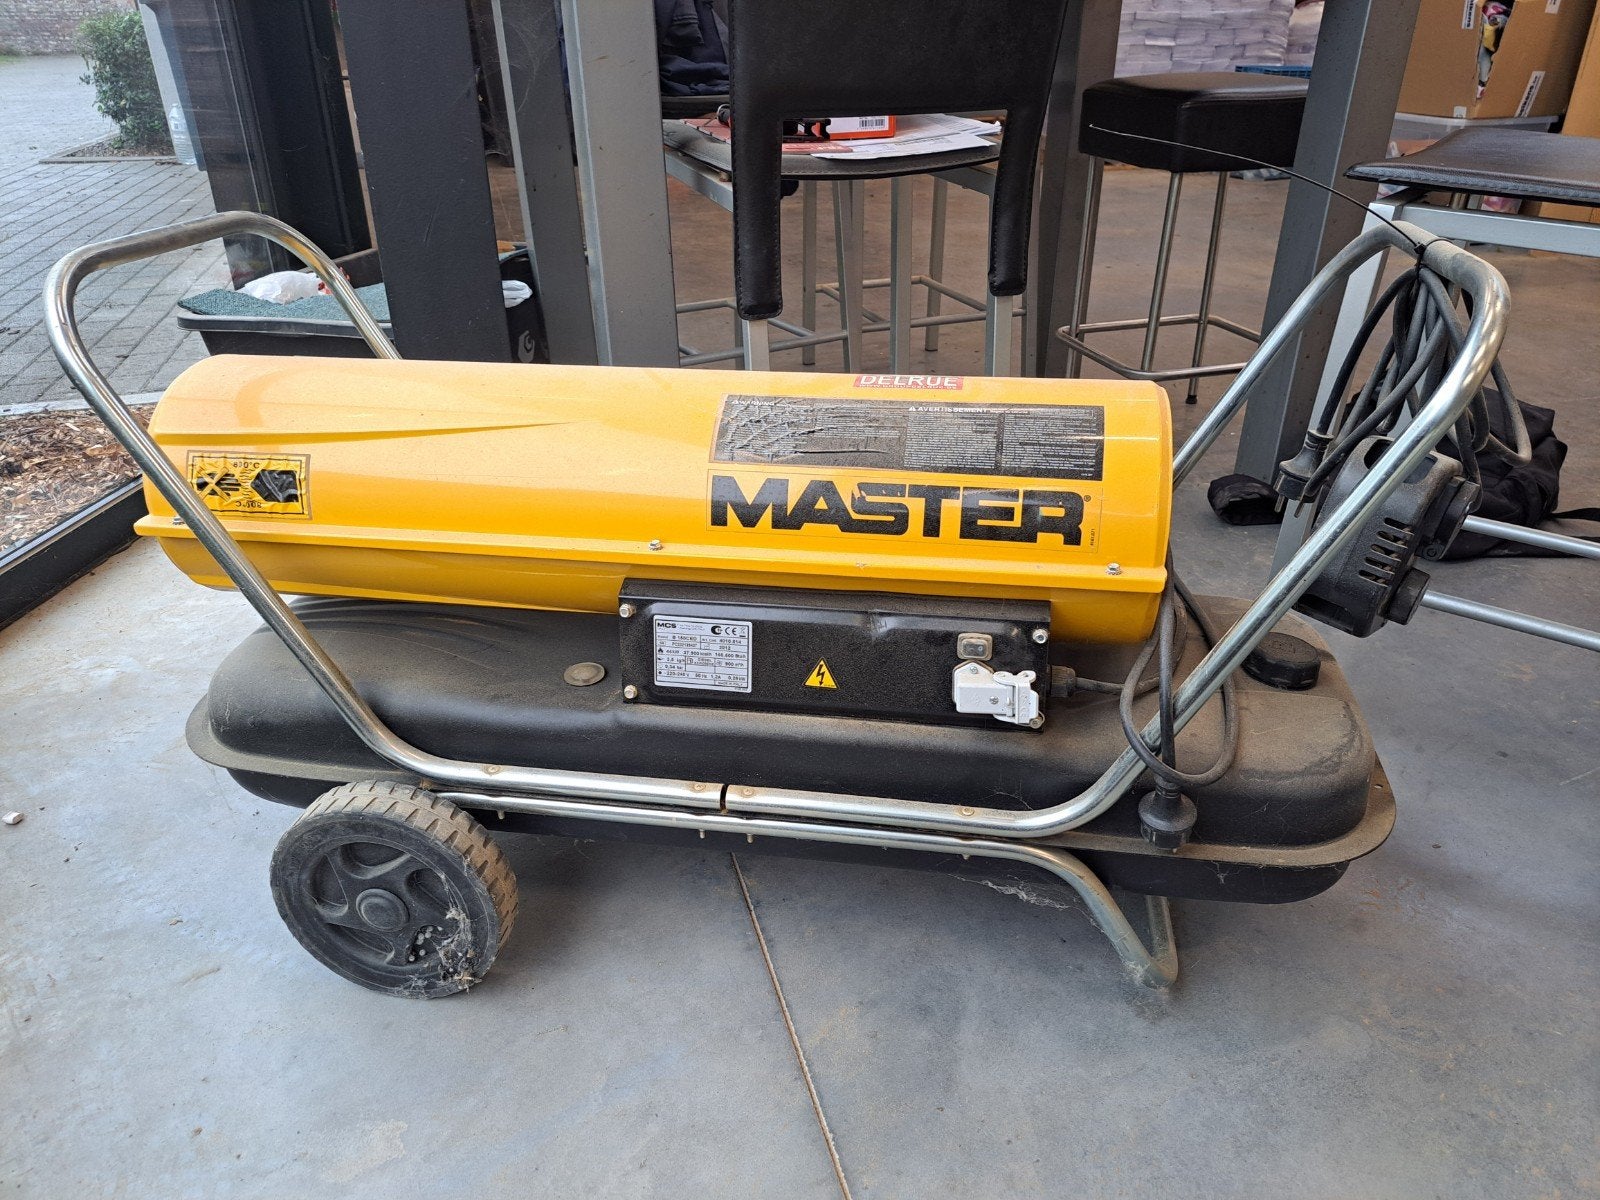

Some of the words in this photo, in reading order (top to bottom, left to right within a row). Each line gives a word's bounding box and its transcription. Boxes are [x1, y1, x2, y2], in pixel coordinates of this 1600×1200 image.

[859, 374, 958, 386] DELRUE
[917, 406, 988, 414] AVERTISSEMENT
[710, 474, 1084, 546] MASTER
